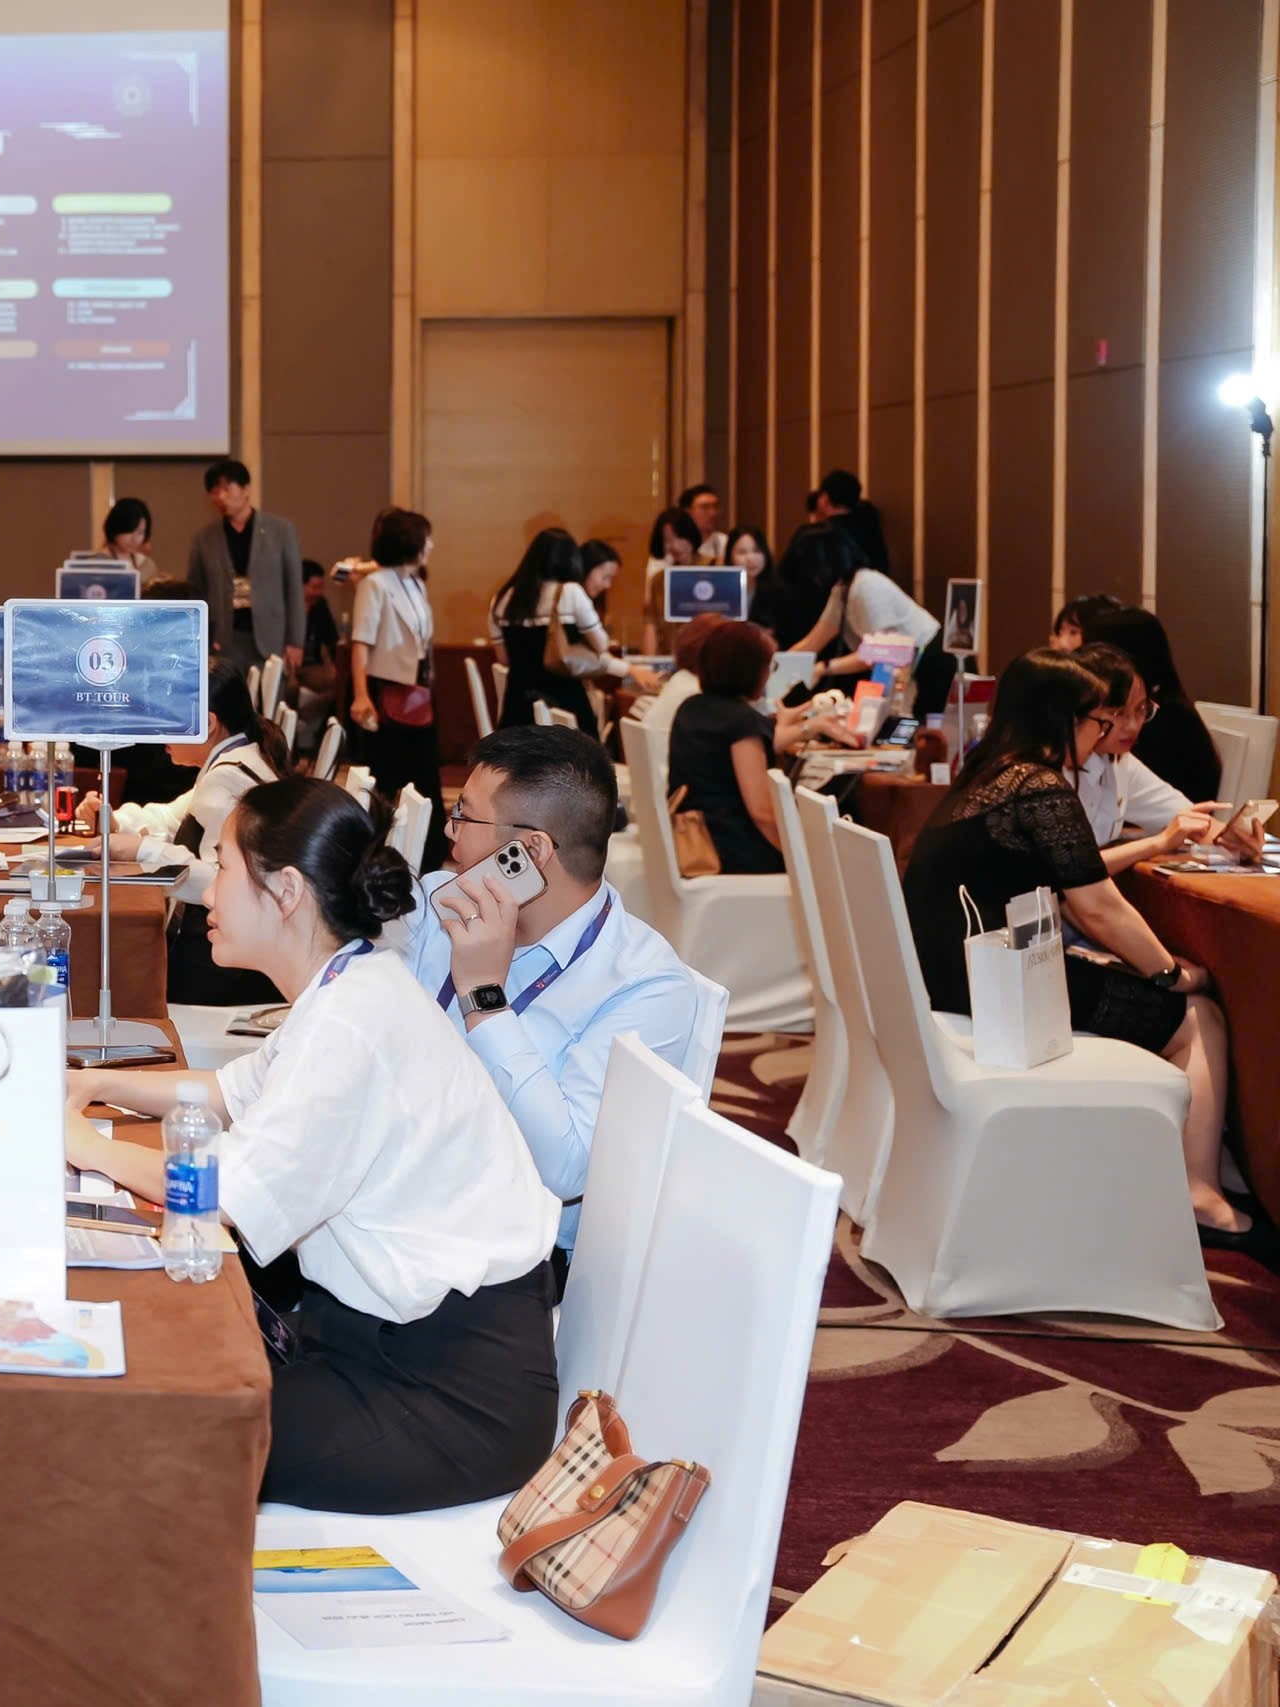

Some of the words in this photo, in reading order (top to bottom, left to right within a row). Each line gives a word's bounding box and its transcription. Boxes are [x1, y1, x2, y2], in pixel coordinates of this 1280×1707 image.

[88, 652, 114, 671] 03
[76, 691, 92, 702] BT
[95, 691, 130, 703] TOUR
